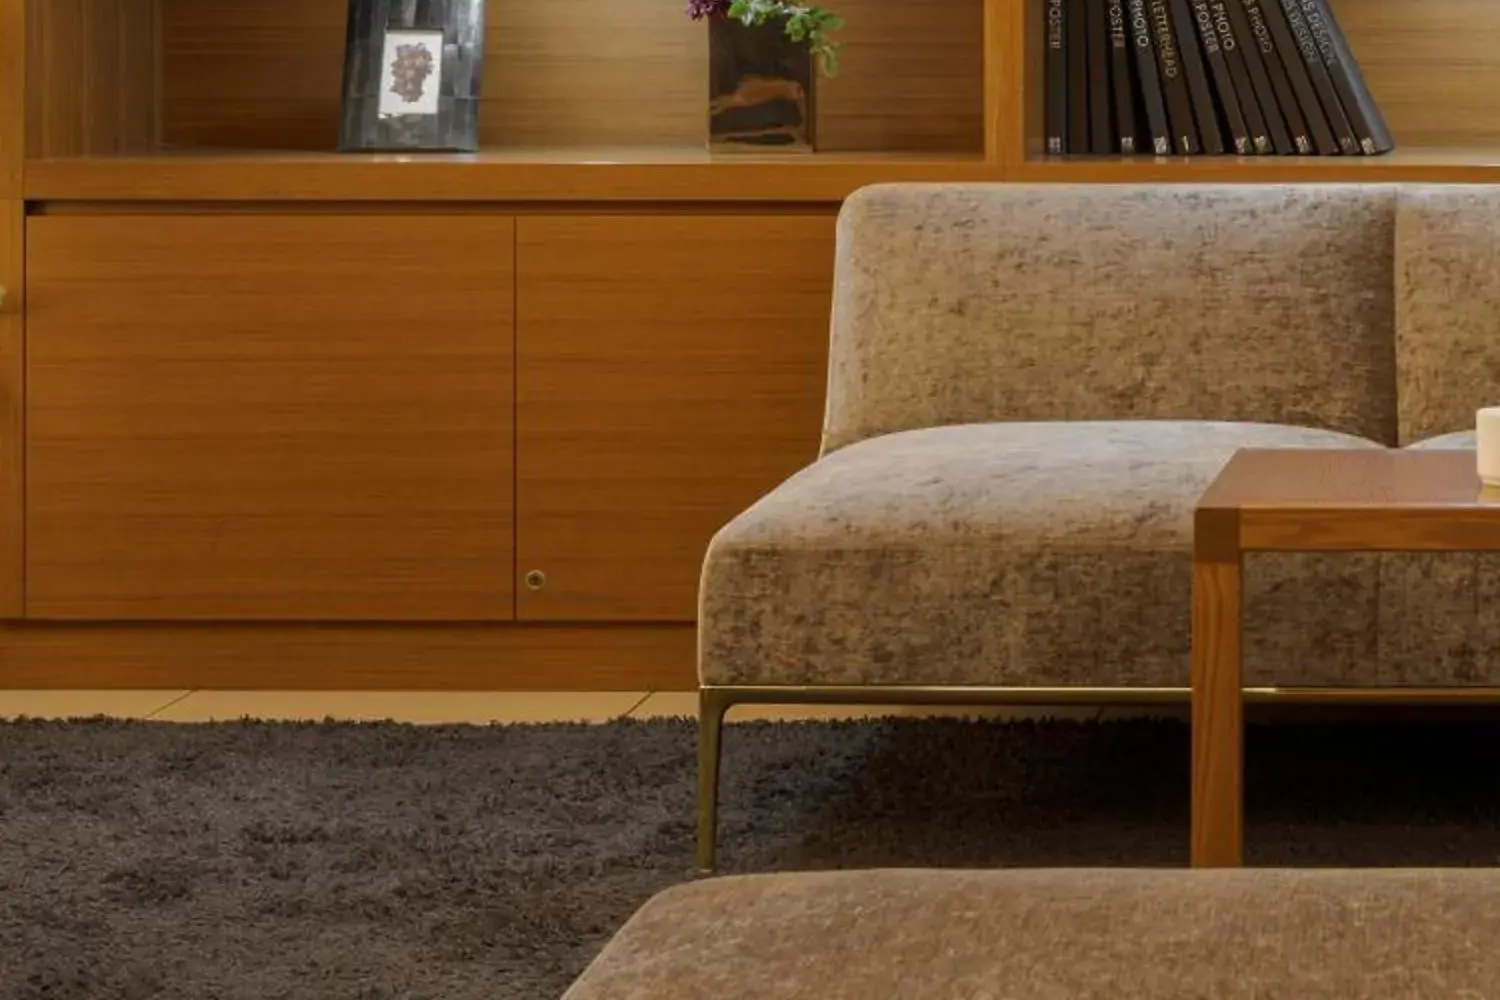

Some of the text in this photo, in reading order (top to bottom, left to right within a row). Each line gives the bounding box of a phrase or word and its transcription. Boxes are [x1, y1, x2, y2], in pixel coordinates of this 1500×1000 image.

[1152, 0, 1178, 78] LETTERHEAD
[1210, 0, 1236, 52] PHOTO
[1246, 4, 1274, 54] PHOTO
